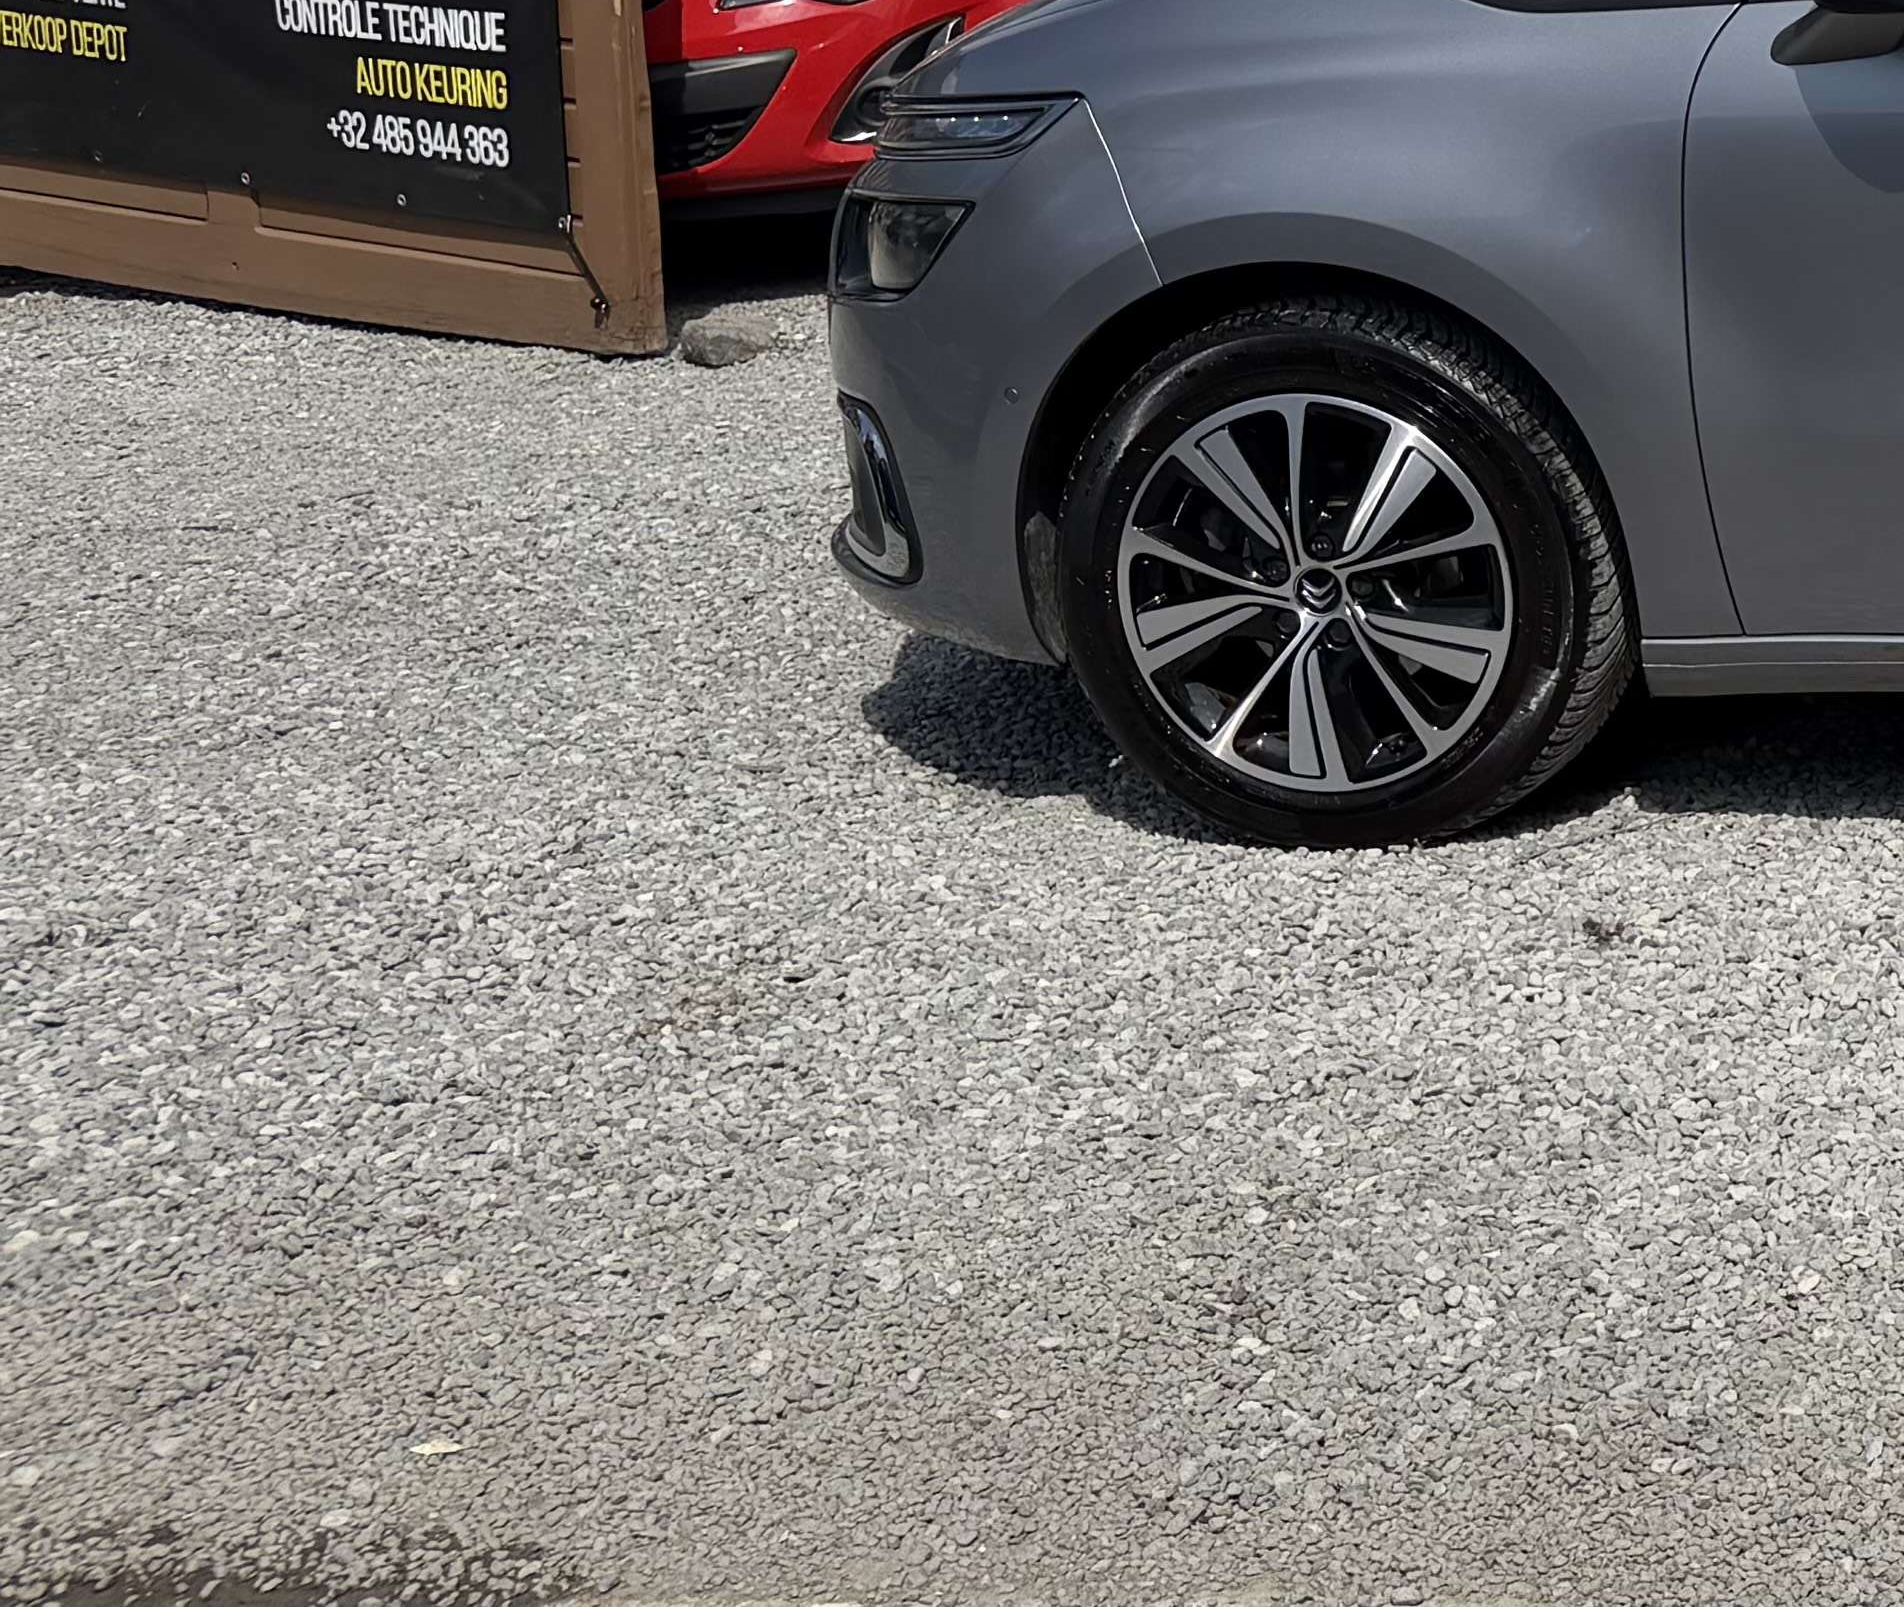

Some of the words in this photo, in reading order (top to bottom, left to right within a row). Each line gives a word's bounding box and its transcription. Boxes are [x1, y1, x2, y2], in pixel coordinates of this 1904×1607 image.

[70, 20, 128, 62] DEPOT
[383, 3, 507, 52] TECHNIQUE
[356, 57, 412, 100] AUTO
[414, 63, 508, 110] KEURING
[326, 110, 370, 151] +32
[372, 114, 415, 156] 485
[416, 119, 462, 162] 944
[463, 125, 510, 168] 363
